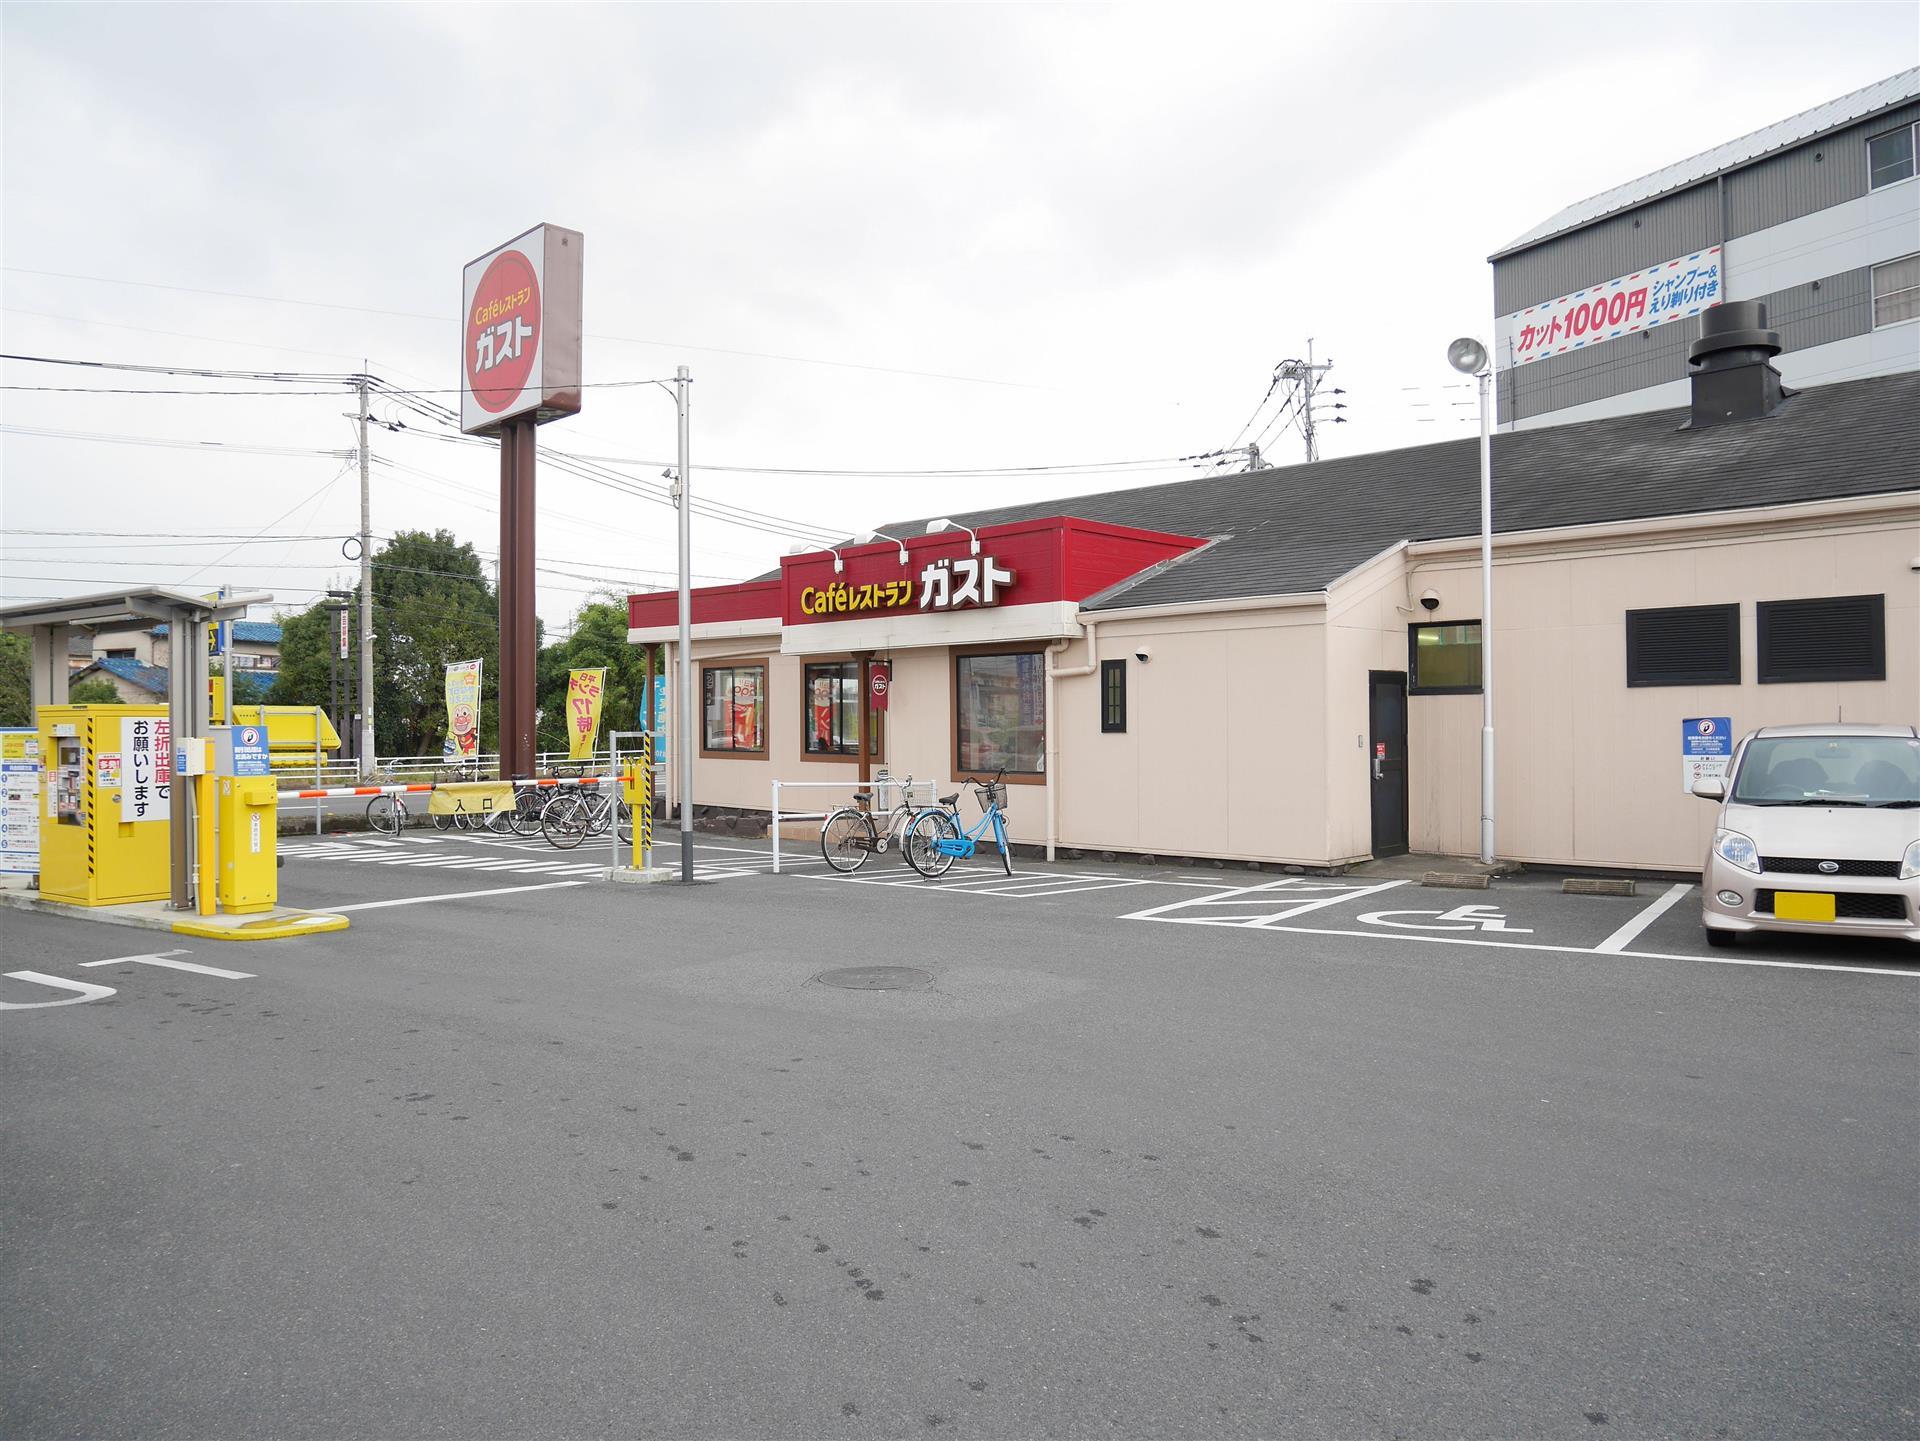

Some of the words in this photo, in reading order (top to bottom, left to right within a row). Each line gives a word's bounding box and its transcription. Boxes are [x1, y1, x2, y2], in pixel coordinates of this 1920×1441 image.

[475, 315, 532, 374] ガスト
[801, 580, 912, 615] Caféレストラン
[920, 556, 1012, 609] ガスト
[132, 720, 149, 817] お願いします
[154, 719, 170, 799] 左折出庫で
[455, 798, 493, 812] 入口
